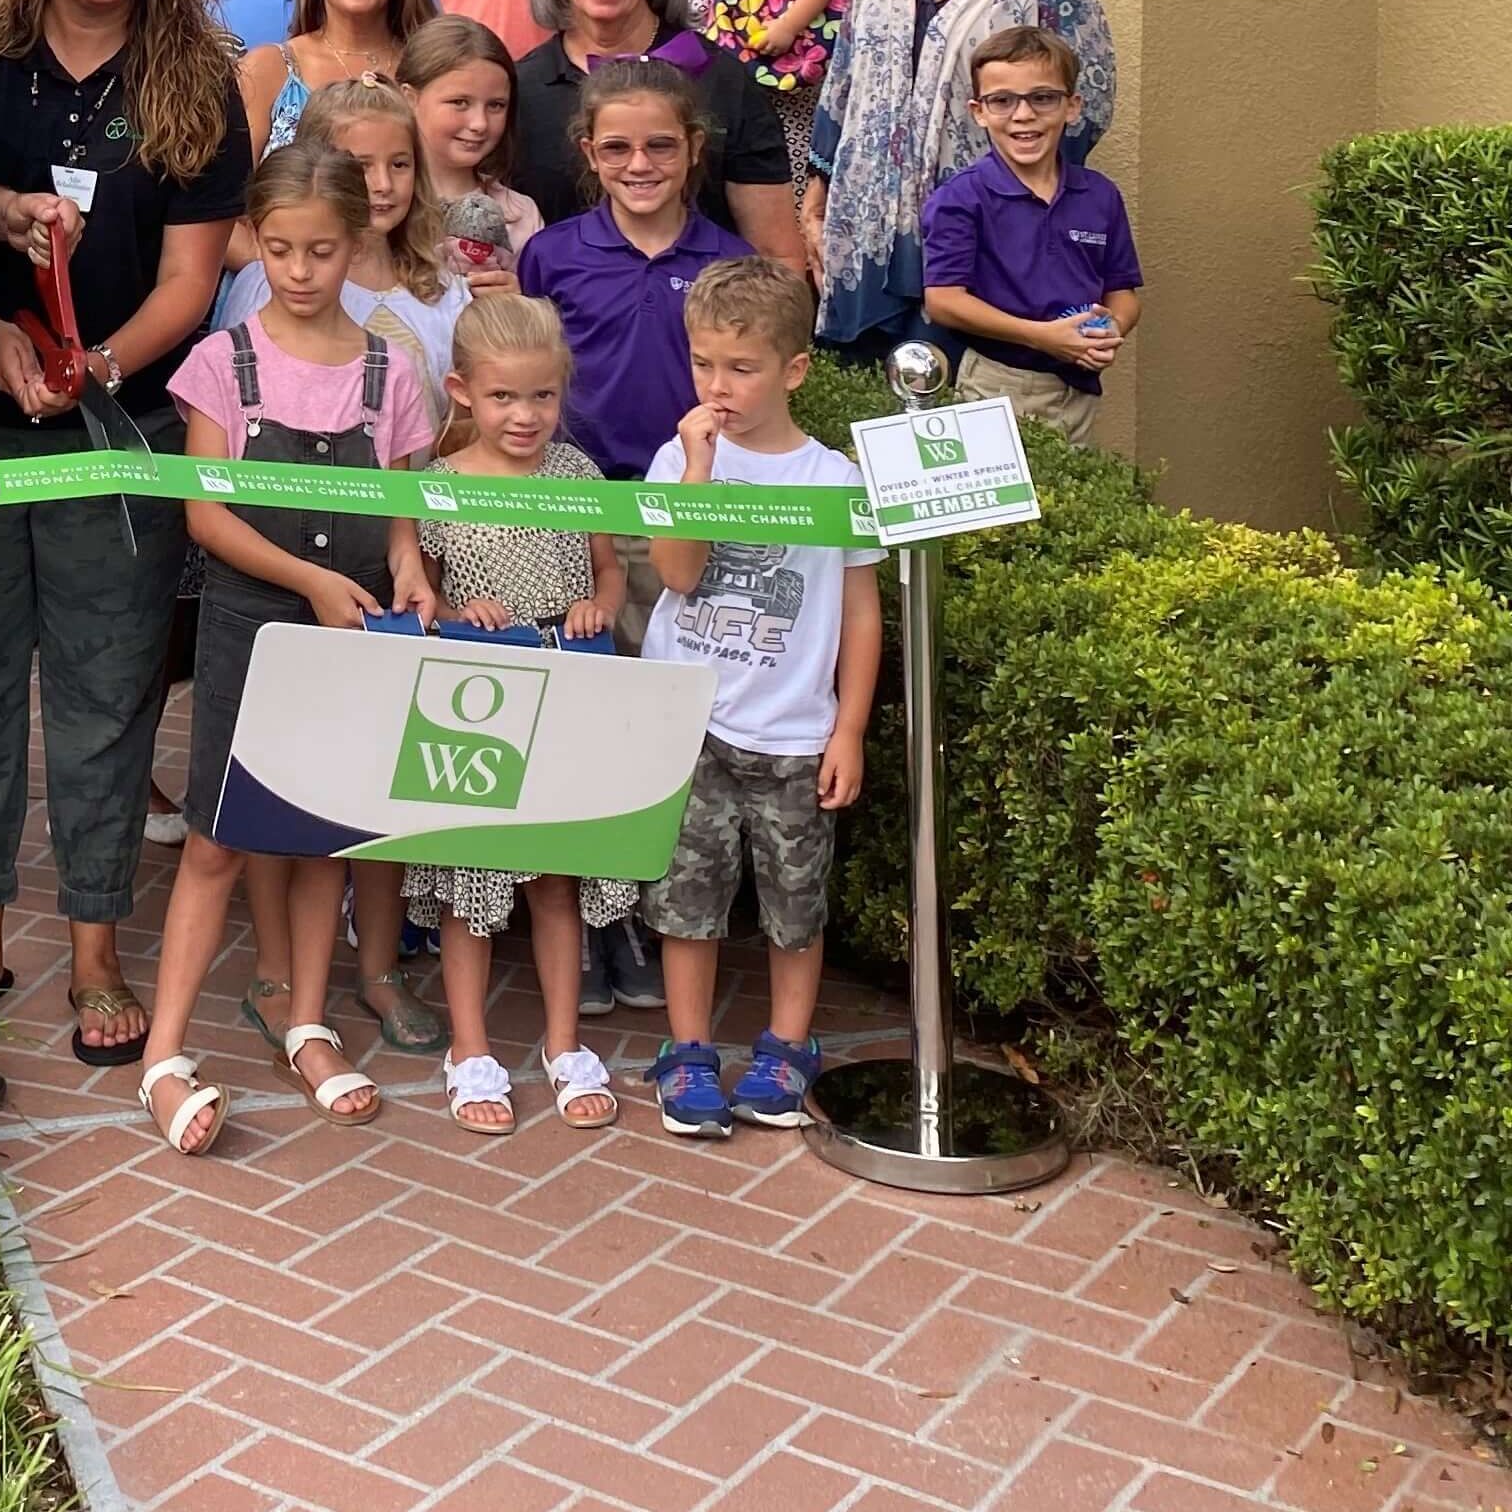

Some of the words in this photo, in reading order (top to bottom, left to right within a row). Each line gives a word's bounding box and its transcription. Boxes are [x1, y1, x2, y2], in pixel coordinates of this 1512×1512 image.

[926, 416, 945, 437] O
[924, 441, 958, 462] WS
[5, 474, 83, 488] REGIONAL
[880, 479, 919, 493] OVIEDO
[932, 470, 970, 483] WINTER
[974, 463, 1017, 476] SPRINGS
[239, 481, 312, 494] REGIONAL
[318, 487, 386, 499] CHAMBER
[882, 486, 951, 505] REGIONAL
[956, 474, 1020, 492] CHAMBER
[461, 498, 532, 510] REGIONAL
[537, 502, 604, 515] CHAMBER
[913, 490, 1000, 519] MEMBER
[676, 511, 745, 524] REGIONAL
[750, 514, 815, 526] CHAMBER
[675, 594, 795, 652] LIFE
[760, 656, 776, 667] FL
[451, 674, 505, 724] O
[417, 741, 503, 797] WS
